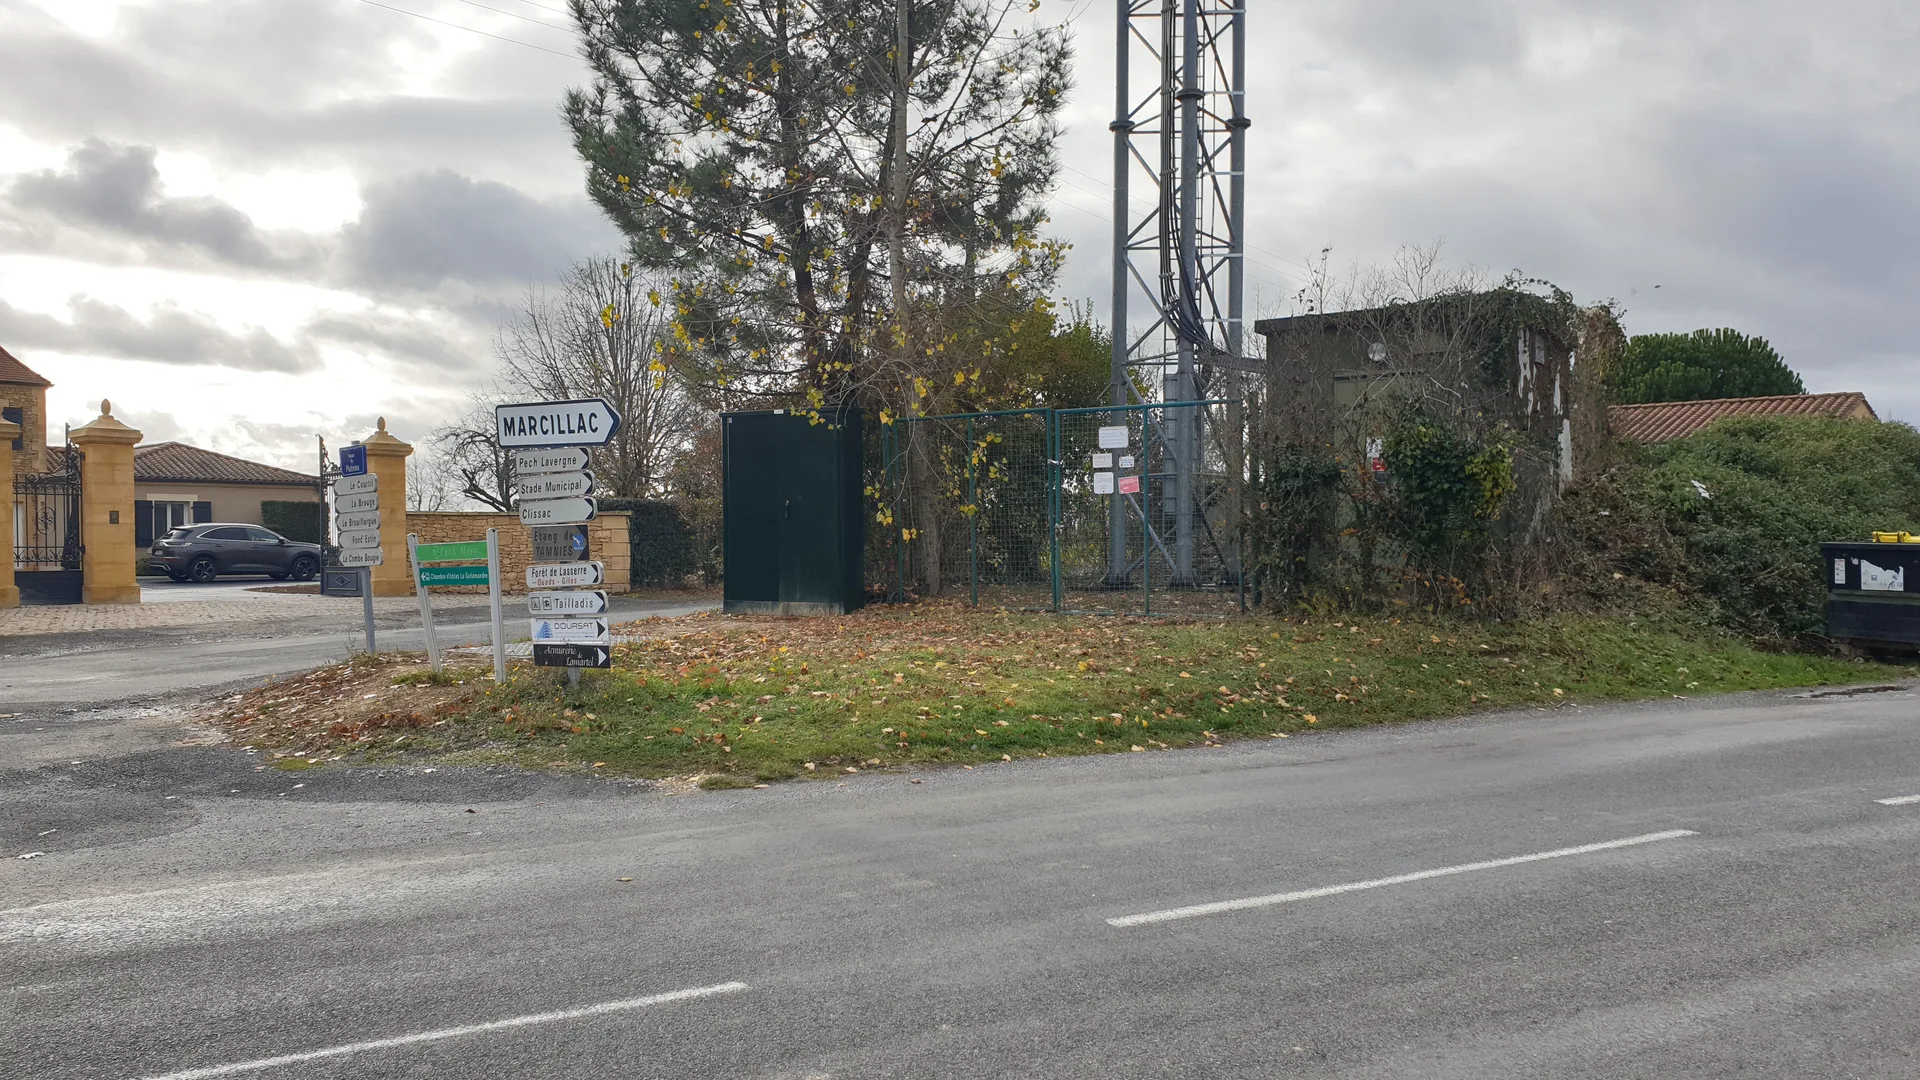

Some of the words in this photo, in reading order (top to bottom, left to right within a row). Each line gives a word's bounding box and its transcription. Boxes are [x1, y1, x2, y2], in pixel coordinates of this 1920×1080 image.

[503, 412, 598, 436] MARCILLAC
[519, 456, 538, 468] Pech
[541, 455, 577, 469] Lavergne
[350, 482, 355, 490] Le
[357, 480, 373, 489] Courtil
[520, 482, 542, 495] Stade
[545, 479, 582, 494] Municipal
[522, 508, 552, 519] Clissac
[342, 519, 347, 527] Le
[563, 529, 574, 541] de
[535, 545, 573, 557] TAMNIES
[343, 555, 348, 563] La
[349, 554, 363, 562] Combe
[531, 567, 548, 578] Forêt
[550, 567, 558, 576] de
[559, 565, 588, 576] Lasserre
[538, 578, 555, 586] Quads
[554, 597, 594, 609] Tailladis
